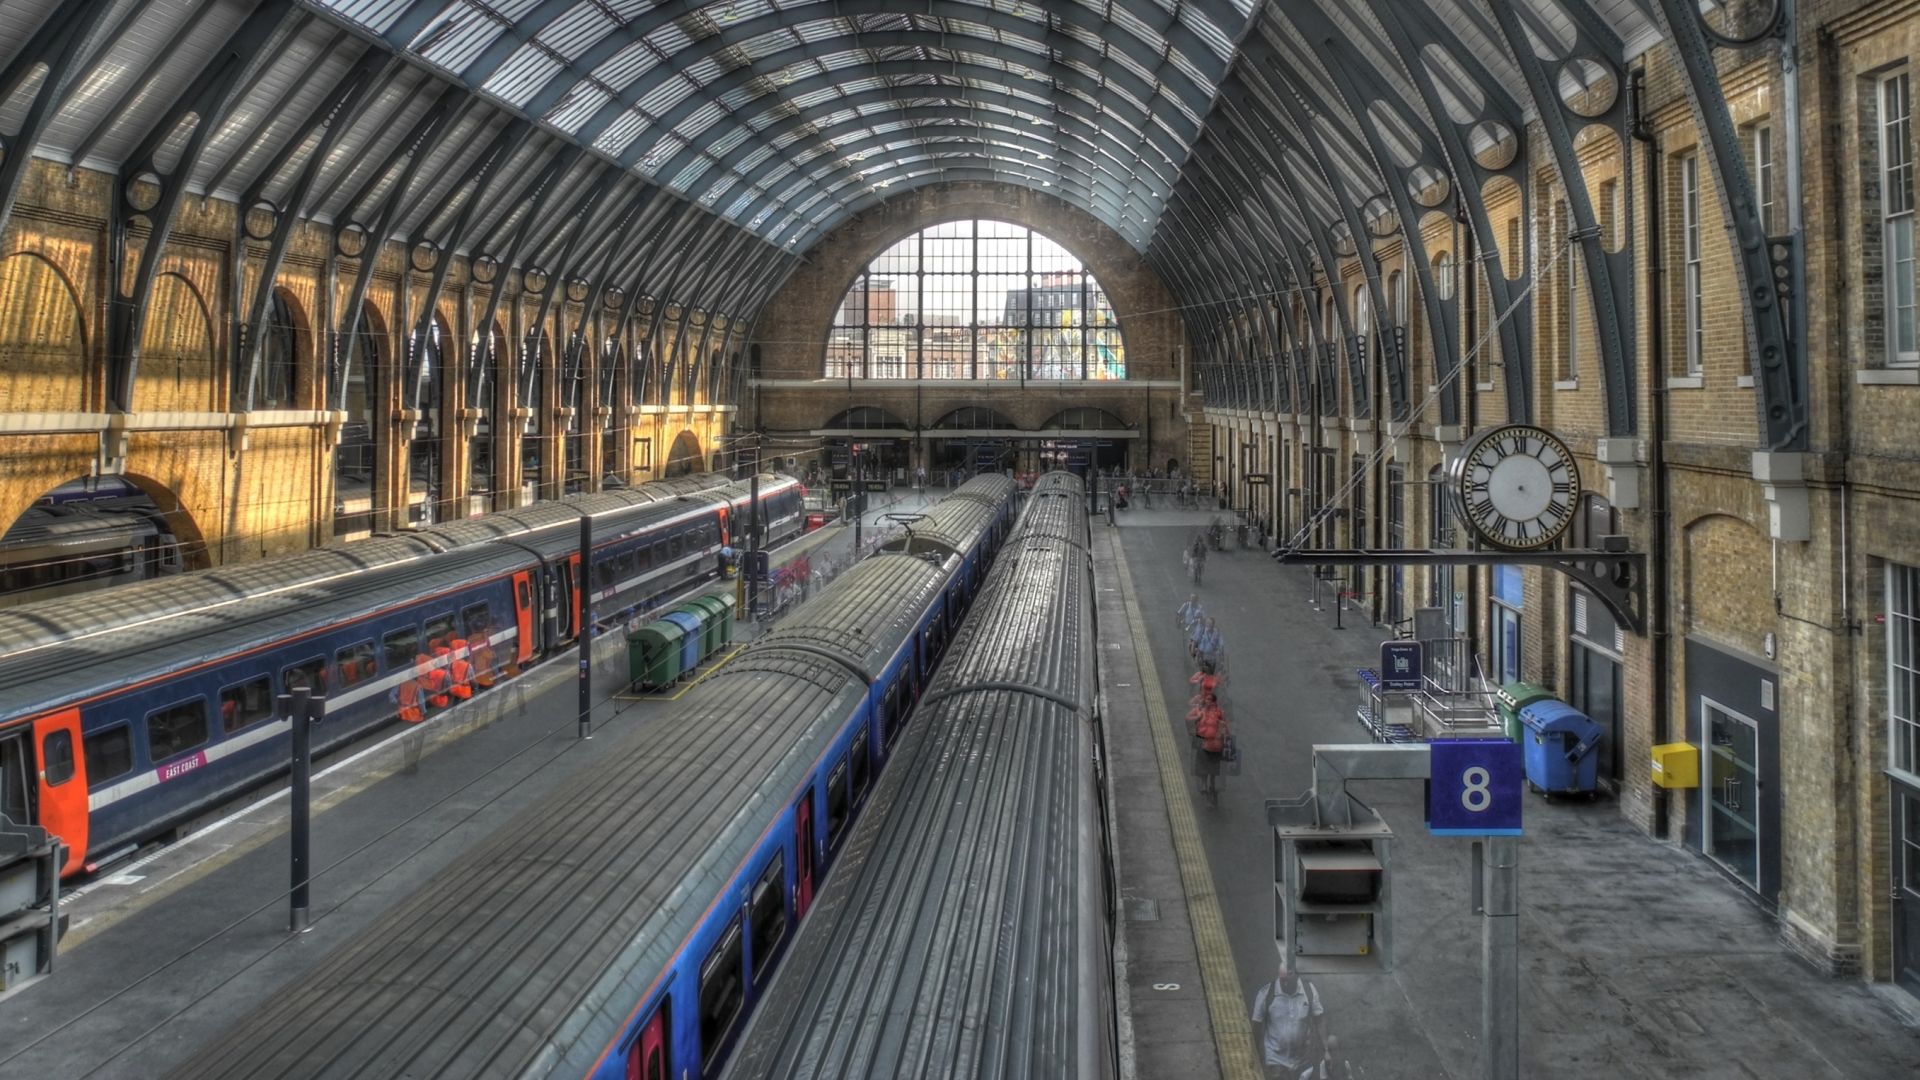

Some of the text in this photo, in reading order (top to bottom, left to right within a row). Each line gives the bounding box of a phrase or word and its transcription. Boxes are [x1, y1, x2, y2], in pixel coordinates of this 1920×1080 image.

[1493, 442, 1508, 460] XI
[1513, 436, 1527, 455] XII
[1536, 442, 1546, 458] I
[1477, 459, 1494, 473] X
[1549, 460, 1564, 473] II
[1472, 481, 1488, 492] IX
[1554, 482, 1570, 493] III
[1475, 498, 1495, 520] VIII
[1547, 500, 1566, 520] IIII
[1492, 515, 1507, 535] VII
[1517, 521, 1528, 539] VI
[1537, 517, 1549, 533] V
[166, 758, 199, 779] EAST COAST
[1461, 766, 1491, 812] 8
